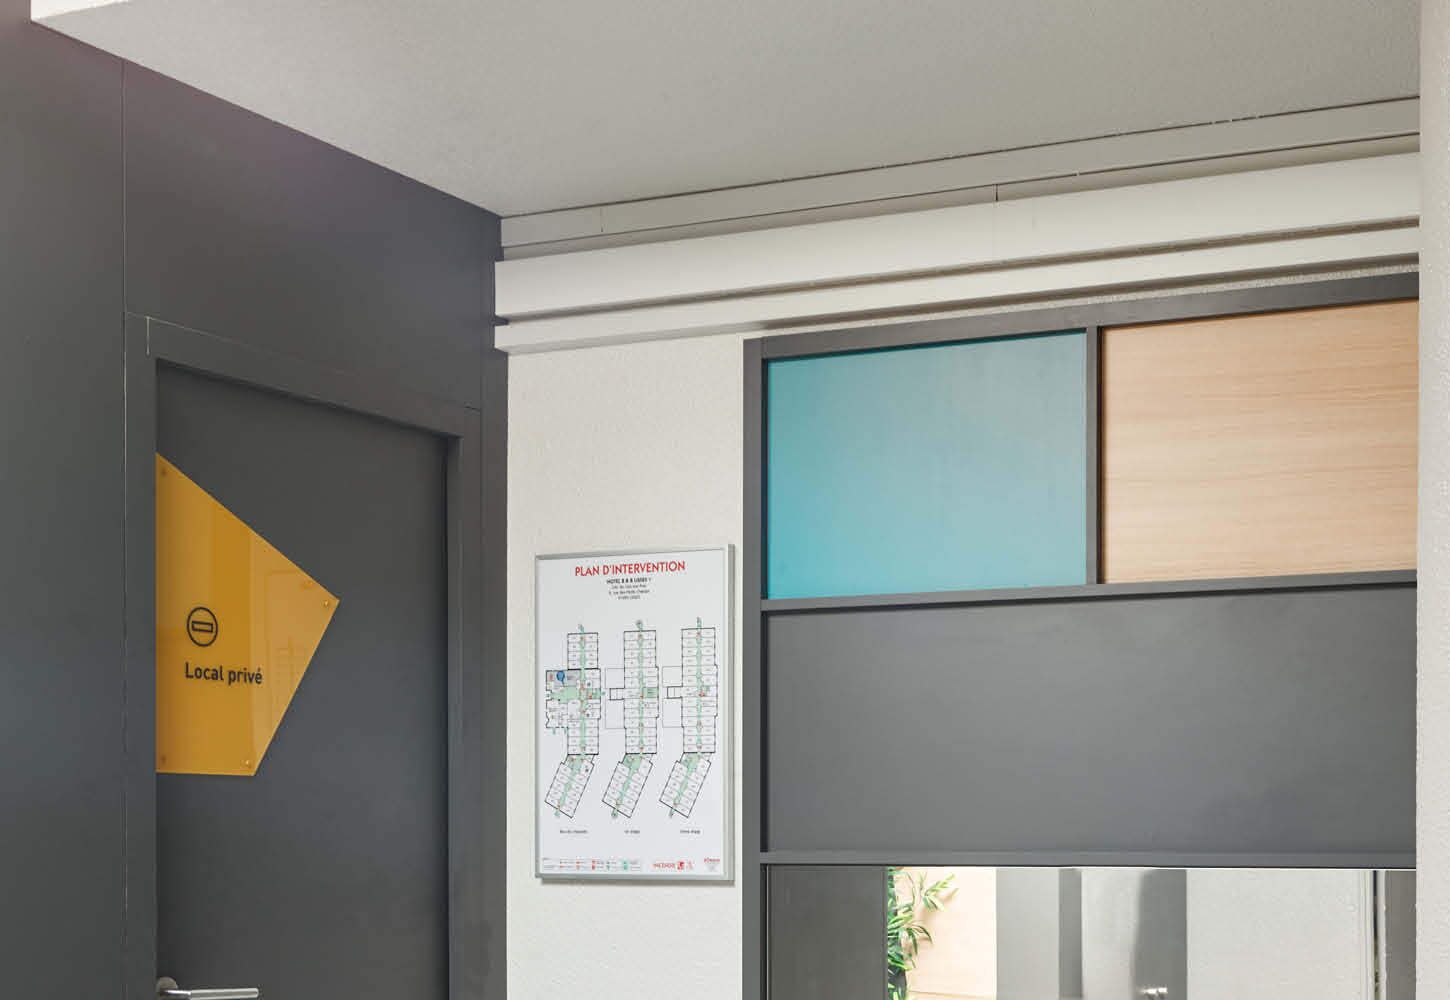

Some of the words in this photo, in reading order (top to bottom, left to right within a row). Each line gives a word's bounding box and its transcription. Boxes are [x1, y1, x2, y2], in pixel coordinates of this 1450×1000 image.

[575, 566, 600, 577] PLAN
[602, 560, 686, 576] D'INTERVENTION
[185, 661, 224, 681] Local
[228, 667, 263, 686] privé
